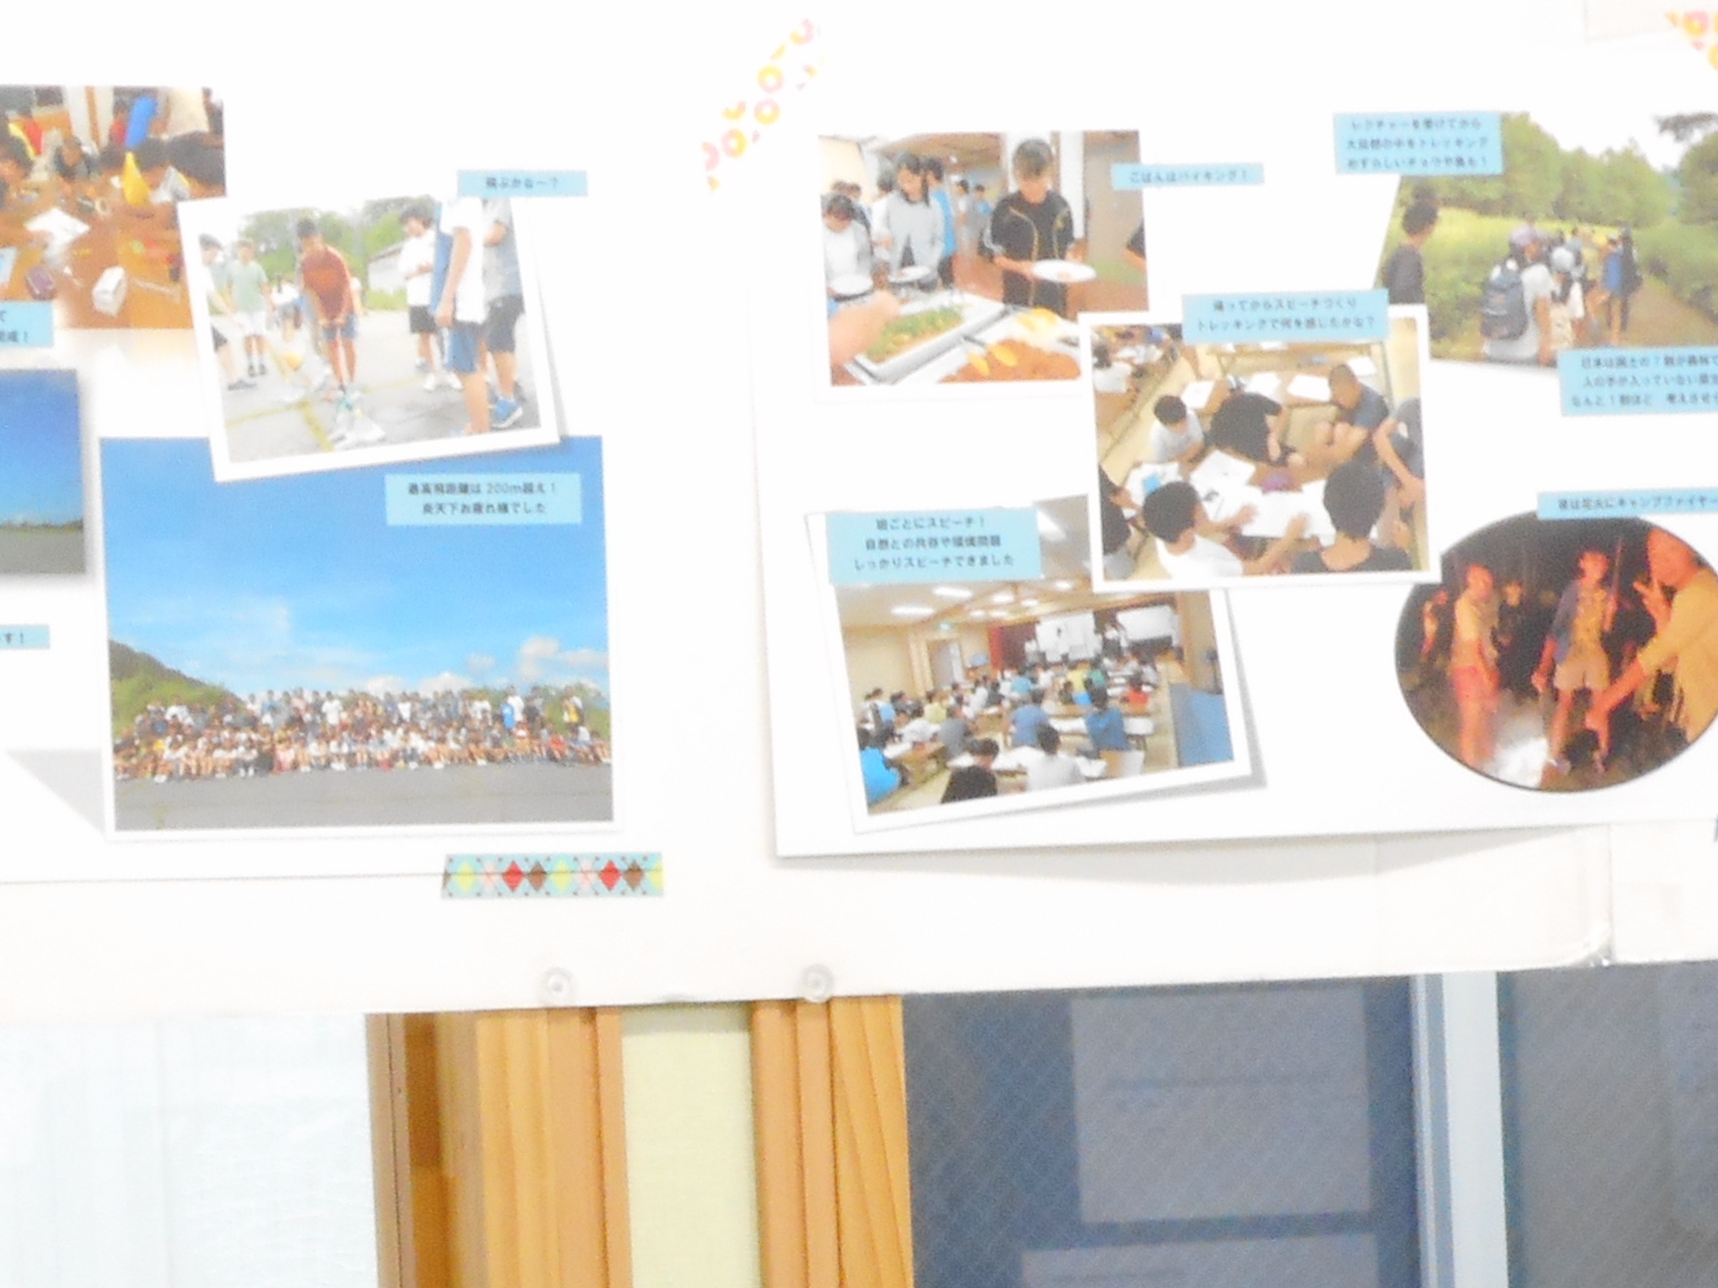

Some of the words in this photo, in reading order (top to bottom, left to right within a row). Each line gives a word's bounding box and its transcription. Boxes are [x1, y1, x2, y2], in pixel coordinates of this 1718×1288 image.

[853, 553, 1015, 572] しっかりスピーチできました
